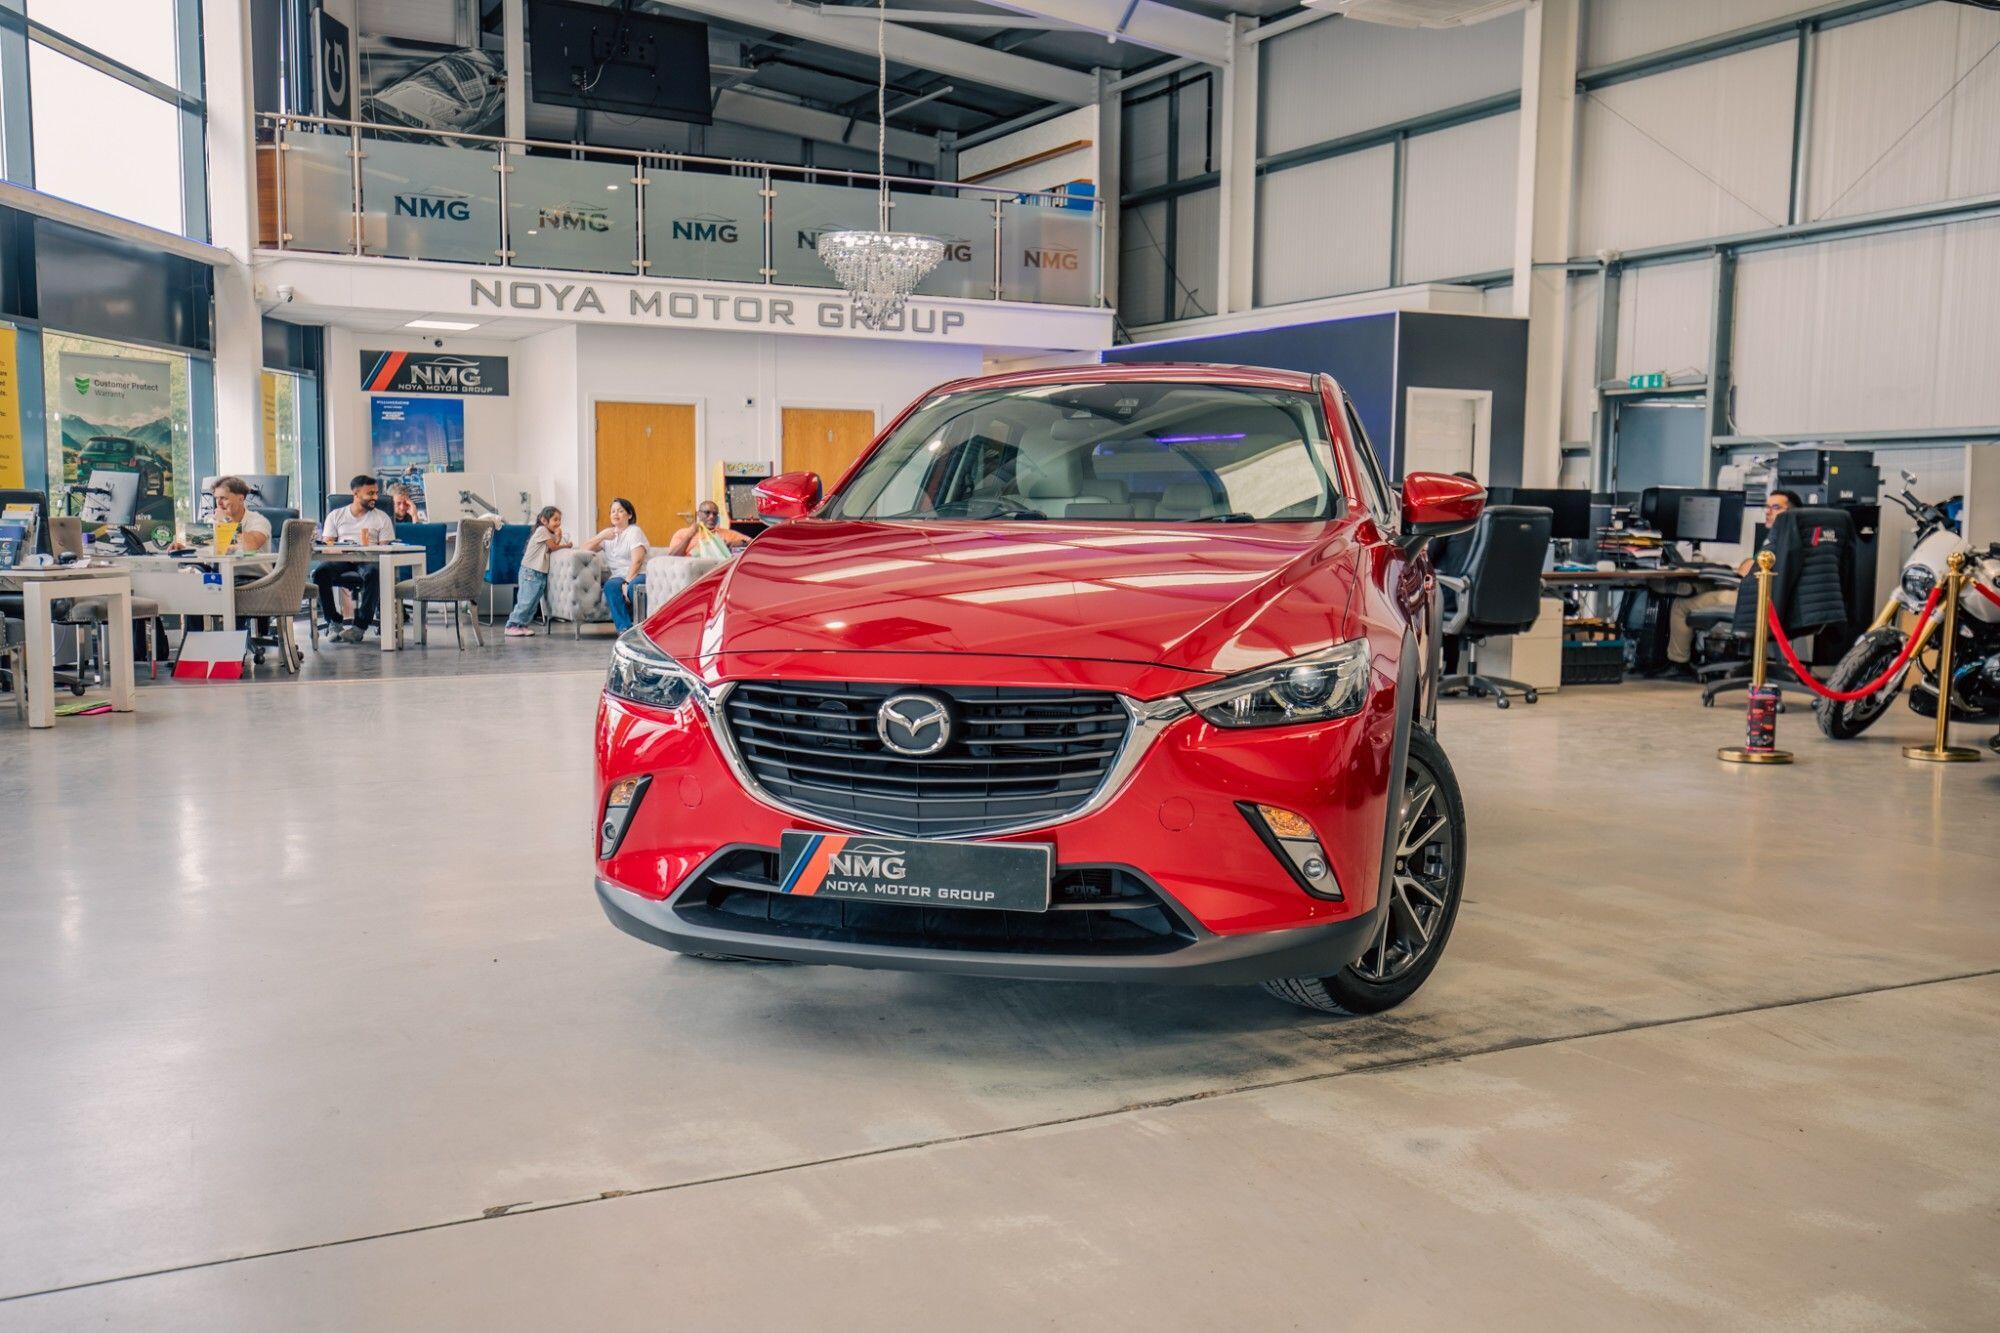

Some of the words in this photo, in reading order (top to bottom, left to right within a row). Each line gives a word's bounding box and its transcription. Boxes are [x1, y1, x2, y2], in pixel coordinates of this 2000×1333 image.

[394, 195, 470, 221] NMG
[538, 208, 610, 232] NMG
[672, 220, 738, 243] NMG
[1024, 250, 1078, 270] NMG
[470, 278, 606, 313] NOYA
[629, 289, 796, 326] MOTOR
[94, 379, 130, 390] Customer
[131, 382, 159, 392] Protect
[410, 364, 482, 387] NMG
[94, 389, 126, 399] Warranty
[398, 383, 424, 392] NOYA
[426, 385, 459, 393] MOTOR
[461, 386, 494, 394] GROUP
[827, 853, 907, 880] NMG
[826, 880, 868, 893] NOYA
[874, 882, 932, 898] MOTOR
[937, 887, 996, 903] GROUP
